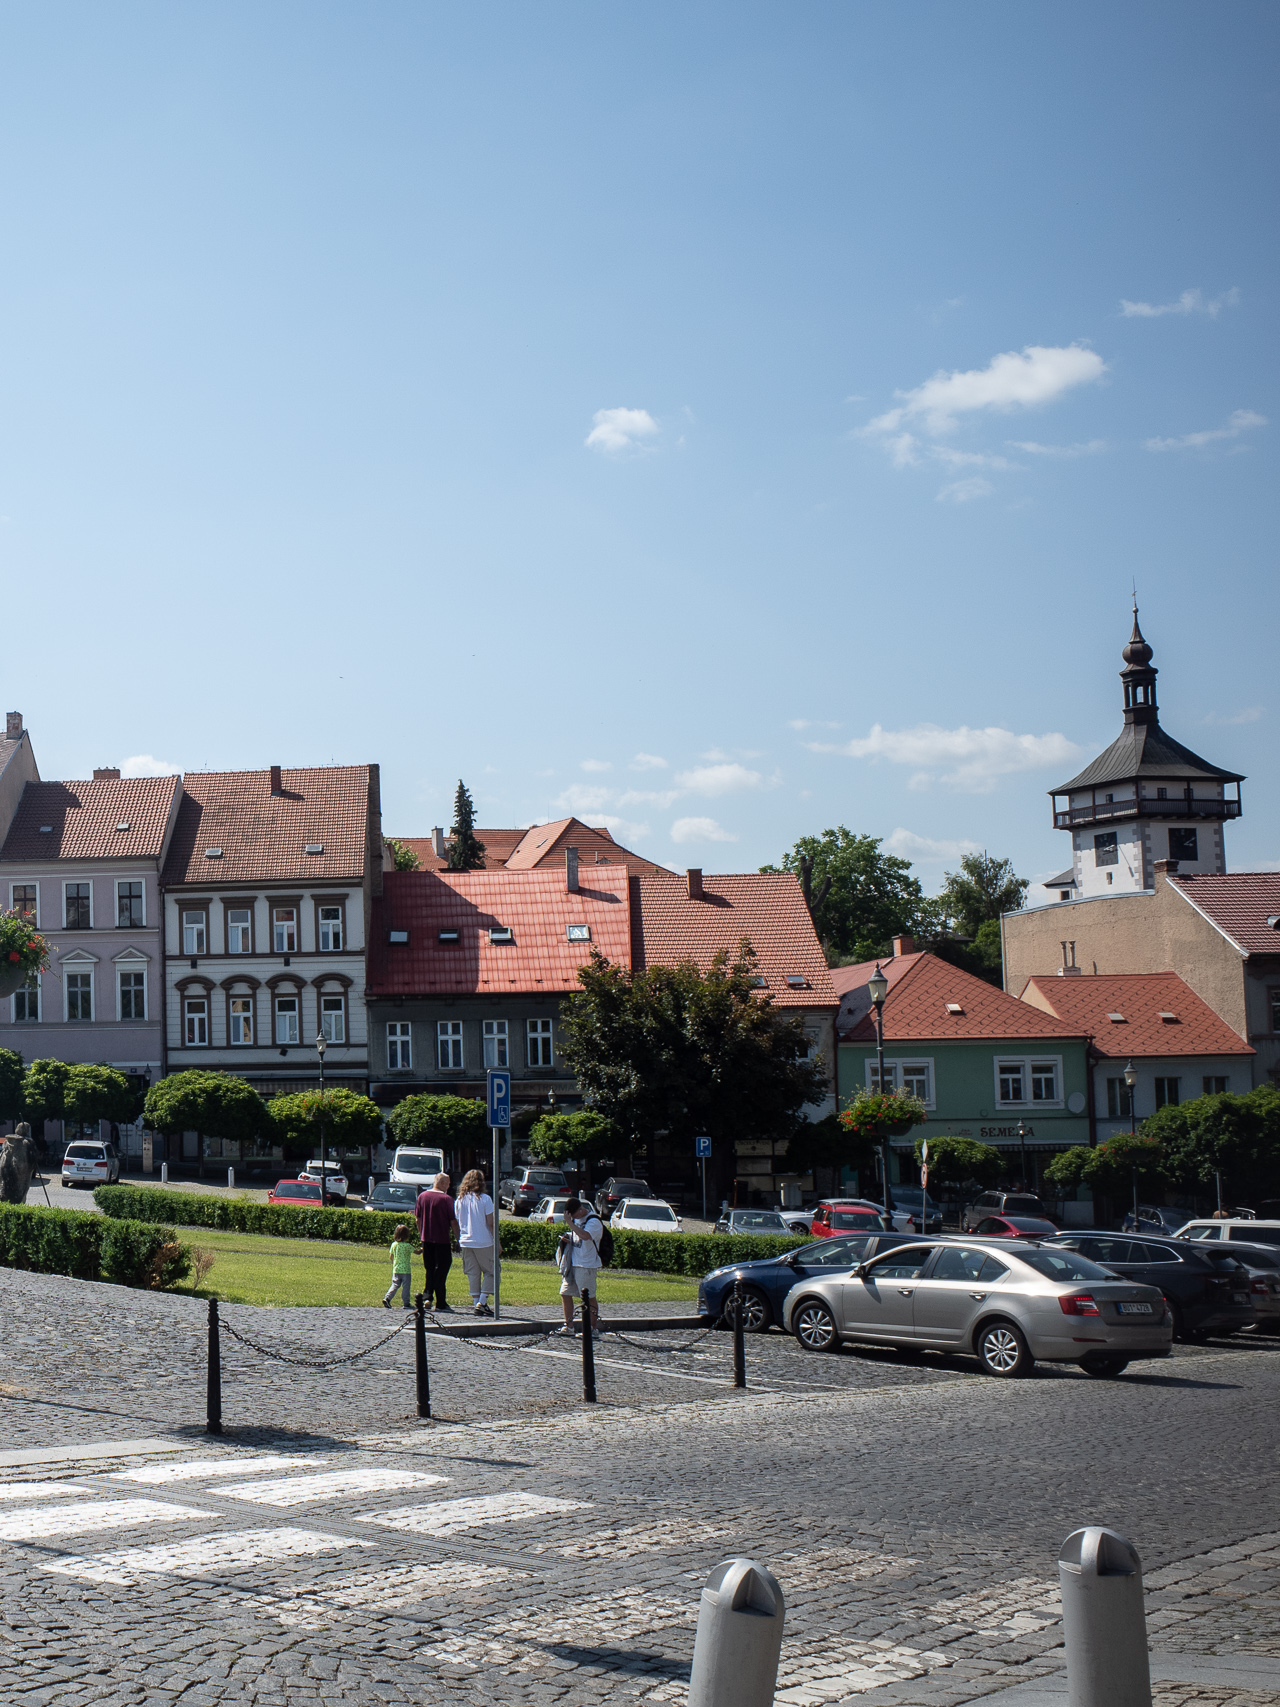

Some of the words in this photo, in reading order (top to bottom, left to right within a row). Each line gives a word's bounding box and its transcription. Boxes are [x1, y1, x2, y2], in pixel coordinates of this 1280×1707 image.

[493, 1078, 506, 1109] P
[512, 1083, 575, 1093] ELEKTROMA
[980, 1126, 1035, 1138] SEMEA
[699, 1138, 709, 1151] P
